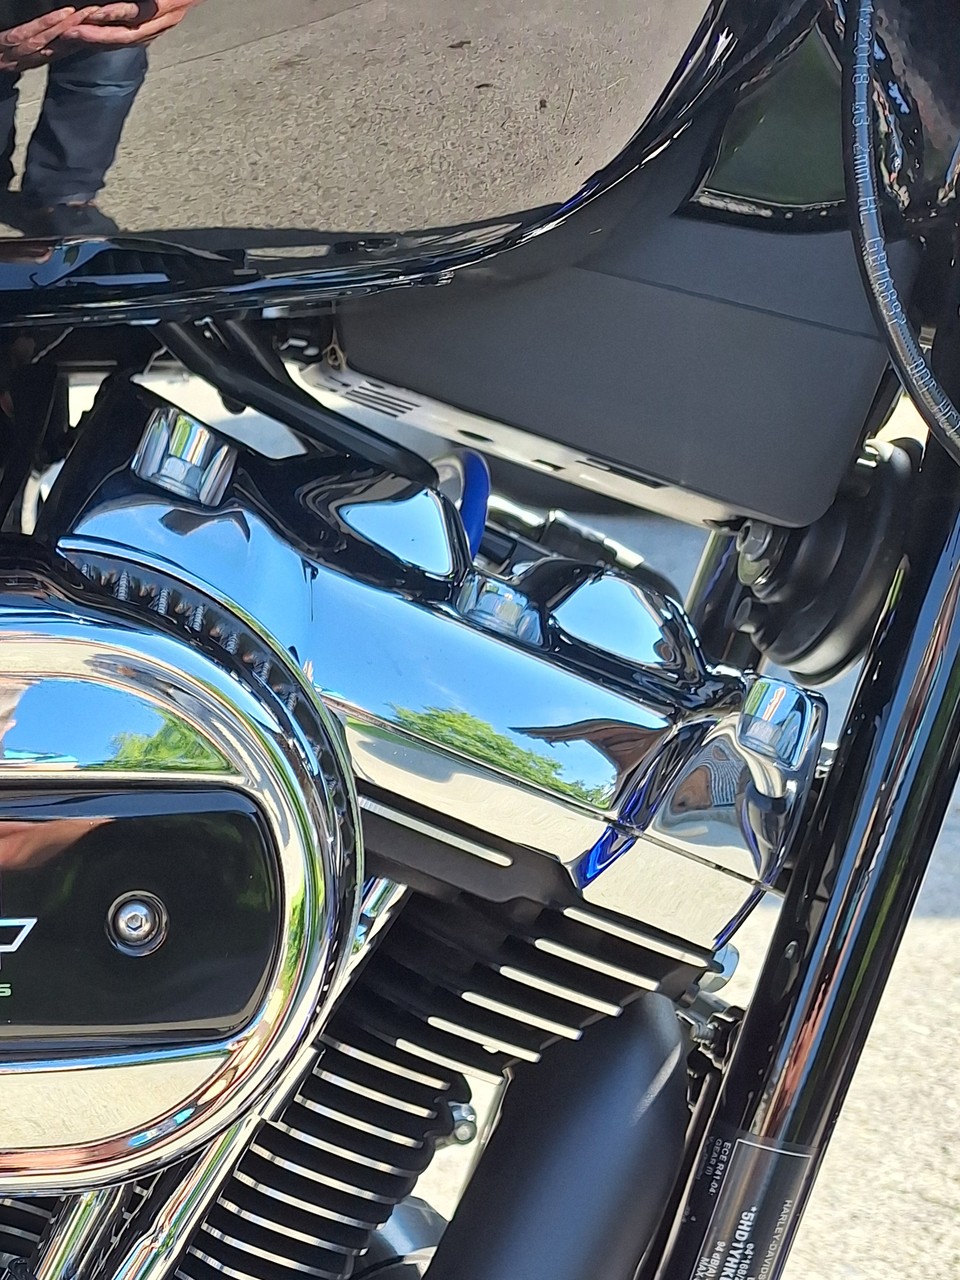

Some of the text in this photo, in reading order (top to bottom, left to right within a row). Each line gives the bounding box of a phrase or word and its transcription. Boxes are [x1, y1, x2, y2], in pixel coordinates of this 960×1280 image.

[717, 1140, 732, 1162] ECE
[713, 1239, 726, 1253] 94
[694, 1255, 710, 1278] MAX
[702, 1250, 722, 1278] dB(A)
